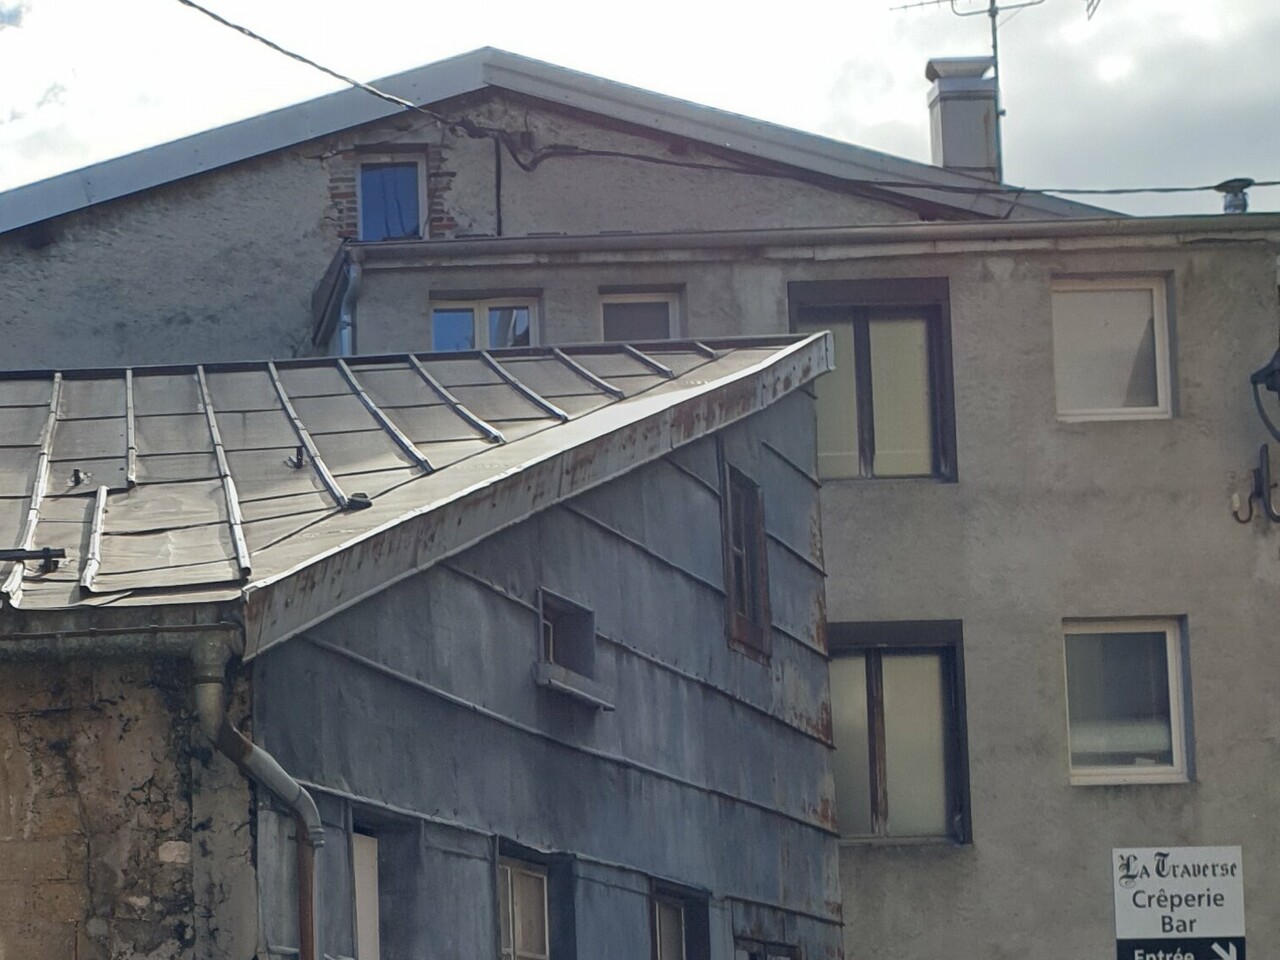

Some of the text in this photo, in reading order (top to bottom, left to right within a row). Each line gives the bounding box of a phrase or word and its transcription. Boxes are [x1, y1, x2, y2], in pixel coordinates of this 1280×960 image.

[1154, 851, 1237, 878] Traverse
[1132, 888, 1224, 912] Crêperie
[1161, 915, 1197, 933] Bar
